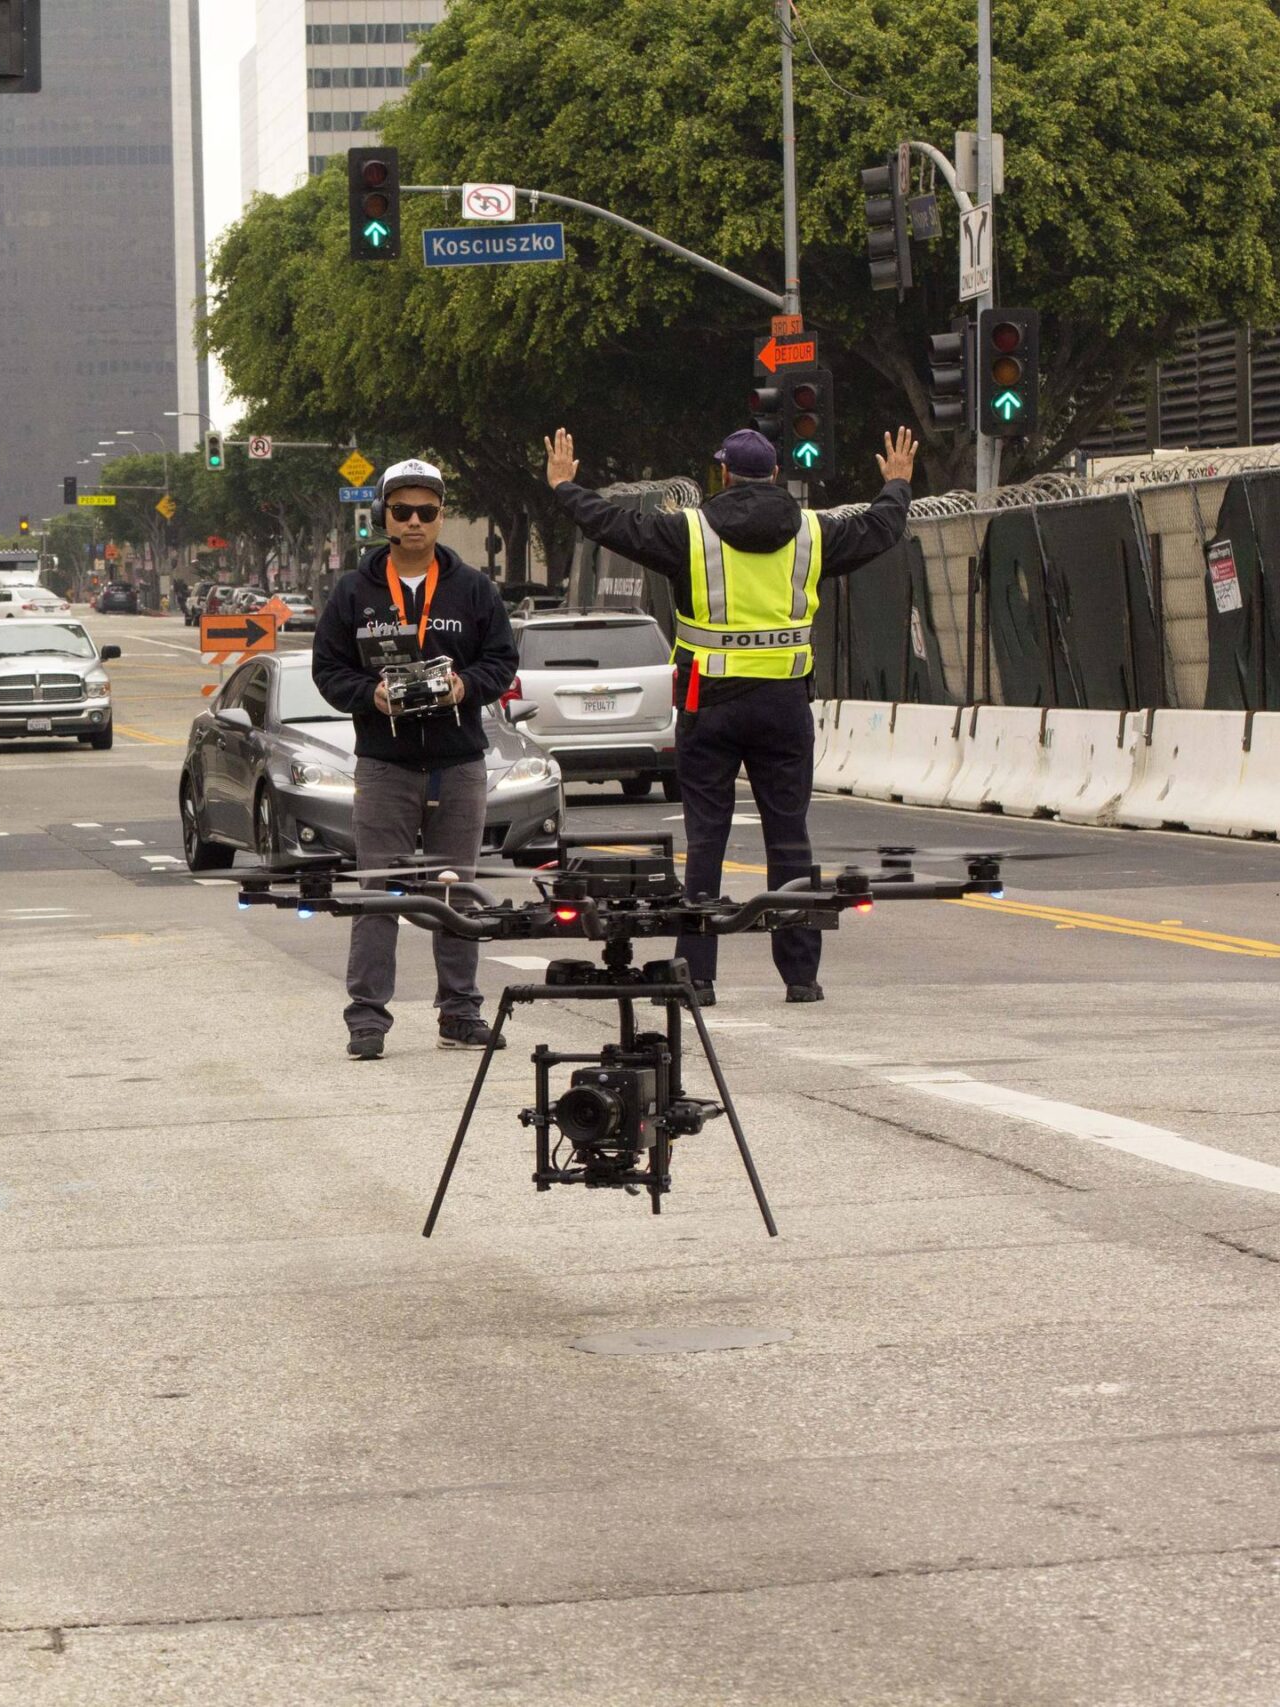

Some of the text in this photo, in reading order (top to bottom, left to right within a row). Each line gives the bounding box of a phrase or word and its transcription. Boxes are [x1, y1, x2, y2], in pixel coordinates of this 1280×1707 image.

[432, 233, 555, 256] Kosciuszko
[774, 320, 801, 335] 3RD ST
[775, 345, 812, 362] DETOUR
[721, 631, 802, 647] POLICE
[583, 701, 615, 711] 7PEU477
